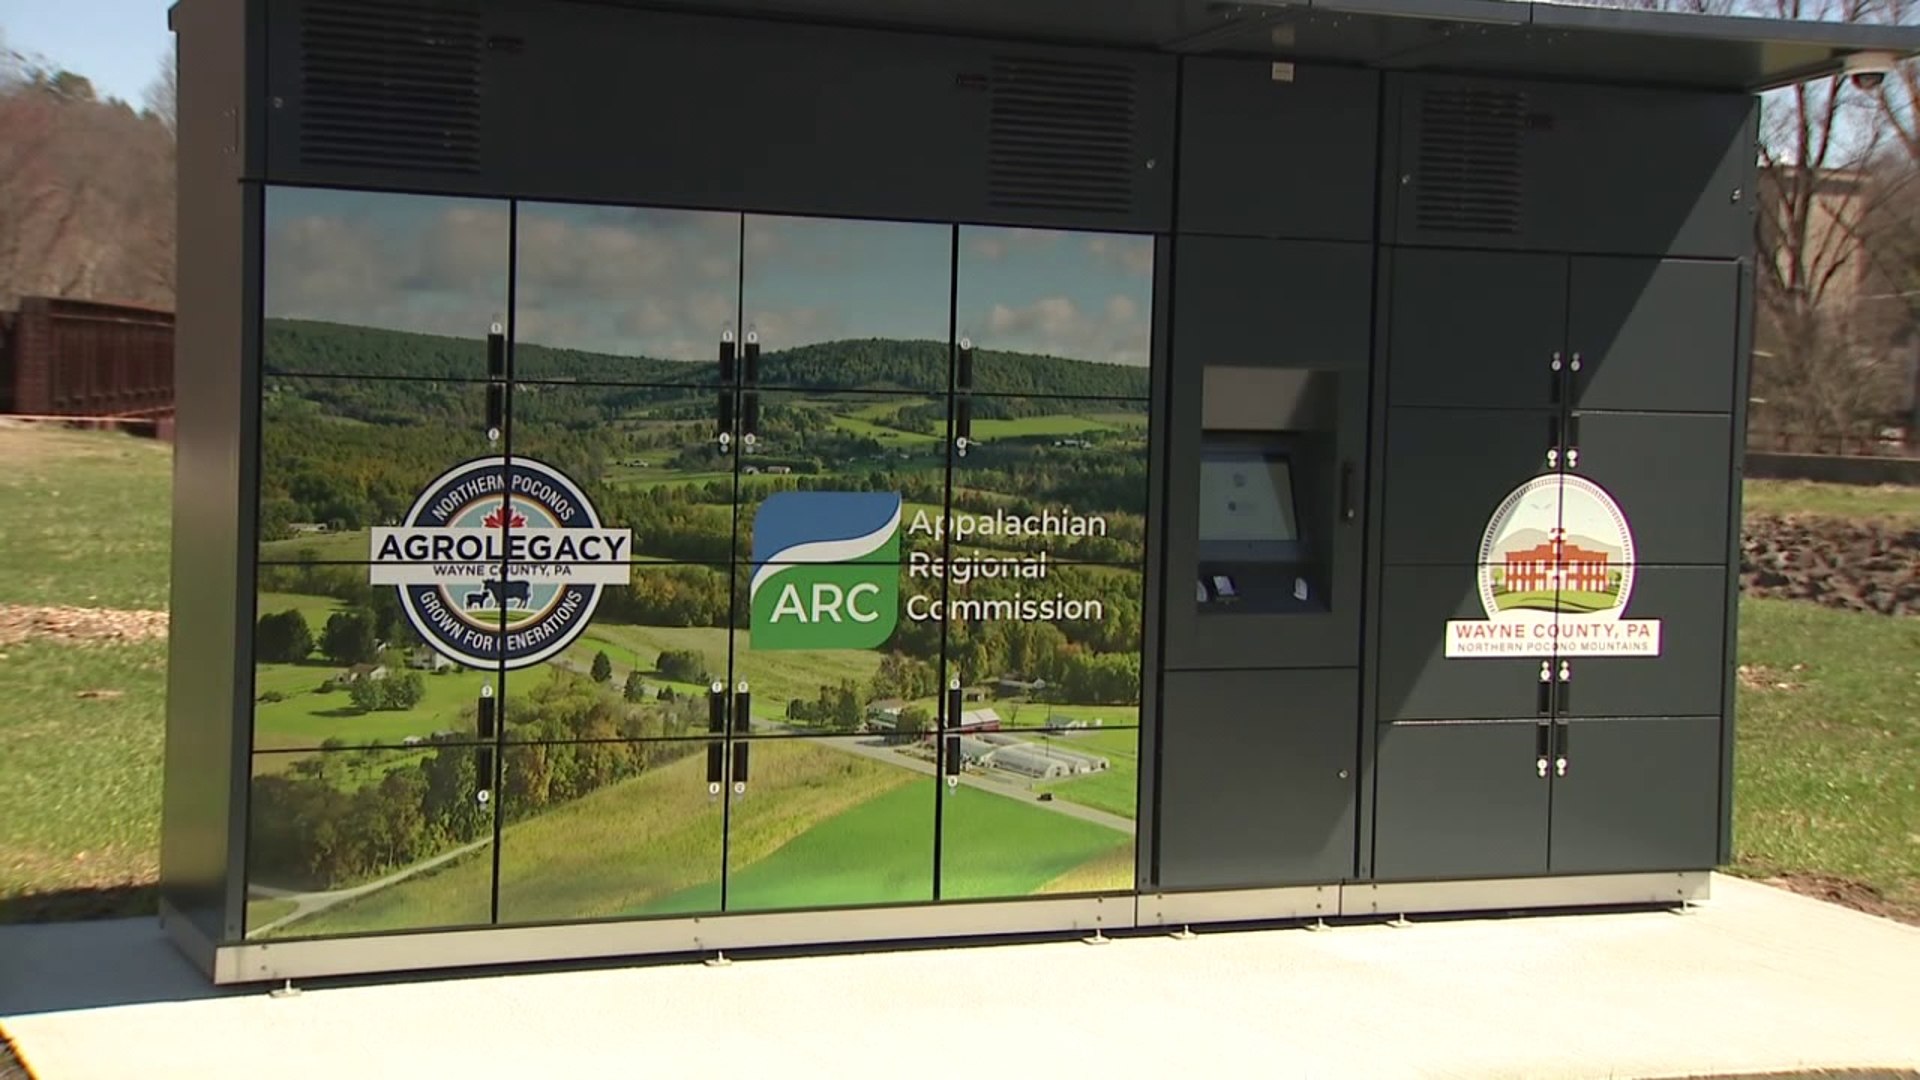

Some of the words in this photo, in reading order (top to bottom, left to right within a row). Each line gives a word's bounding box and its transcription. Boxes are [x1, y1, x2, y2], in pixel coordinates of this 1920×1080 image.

[511, 474, 576, 522] POCONOS
[907, 507, 1107, 542] Appalachian
[377, 534, 626, 560] AGROLEGACY
[433, 564, 485, 577] WAYNE
[554, 564, 572, 577] PA
[908, 549, 1047, 585] Regional
[769, 582, 880, 624] ARC
[906, 592, 1103, 621] Commission
[420, 590, 466, 641] GROWN
[463, 629, 493, 652] FOR
[497, 589, 583, 652] ENERATIONS
[1455, 623, 1526, 639] WAYNE
[1533, 623, 1620, 640] COUNTY,
[1626, 622, 1651, 638] PA
[1457, 642, 1523, 653] NORTHERN
[1526, 641, 1577, 652] POCONO
[1580, 640, 1649, 652] MOUNTAINS
